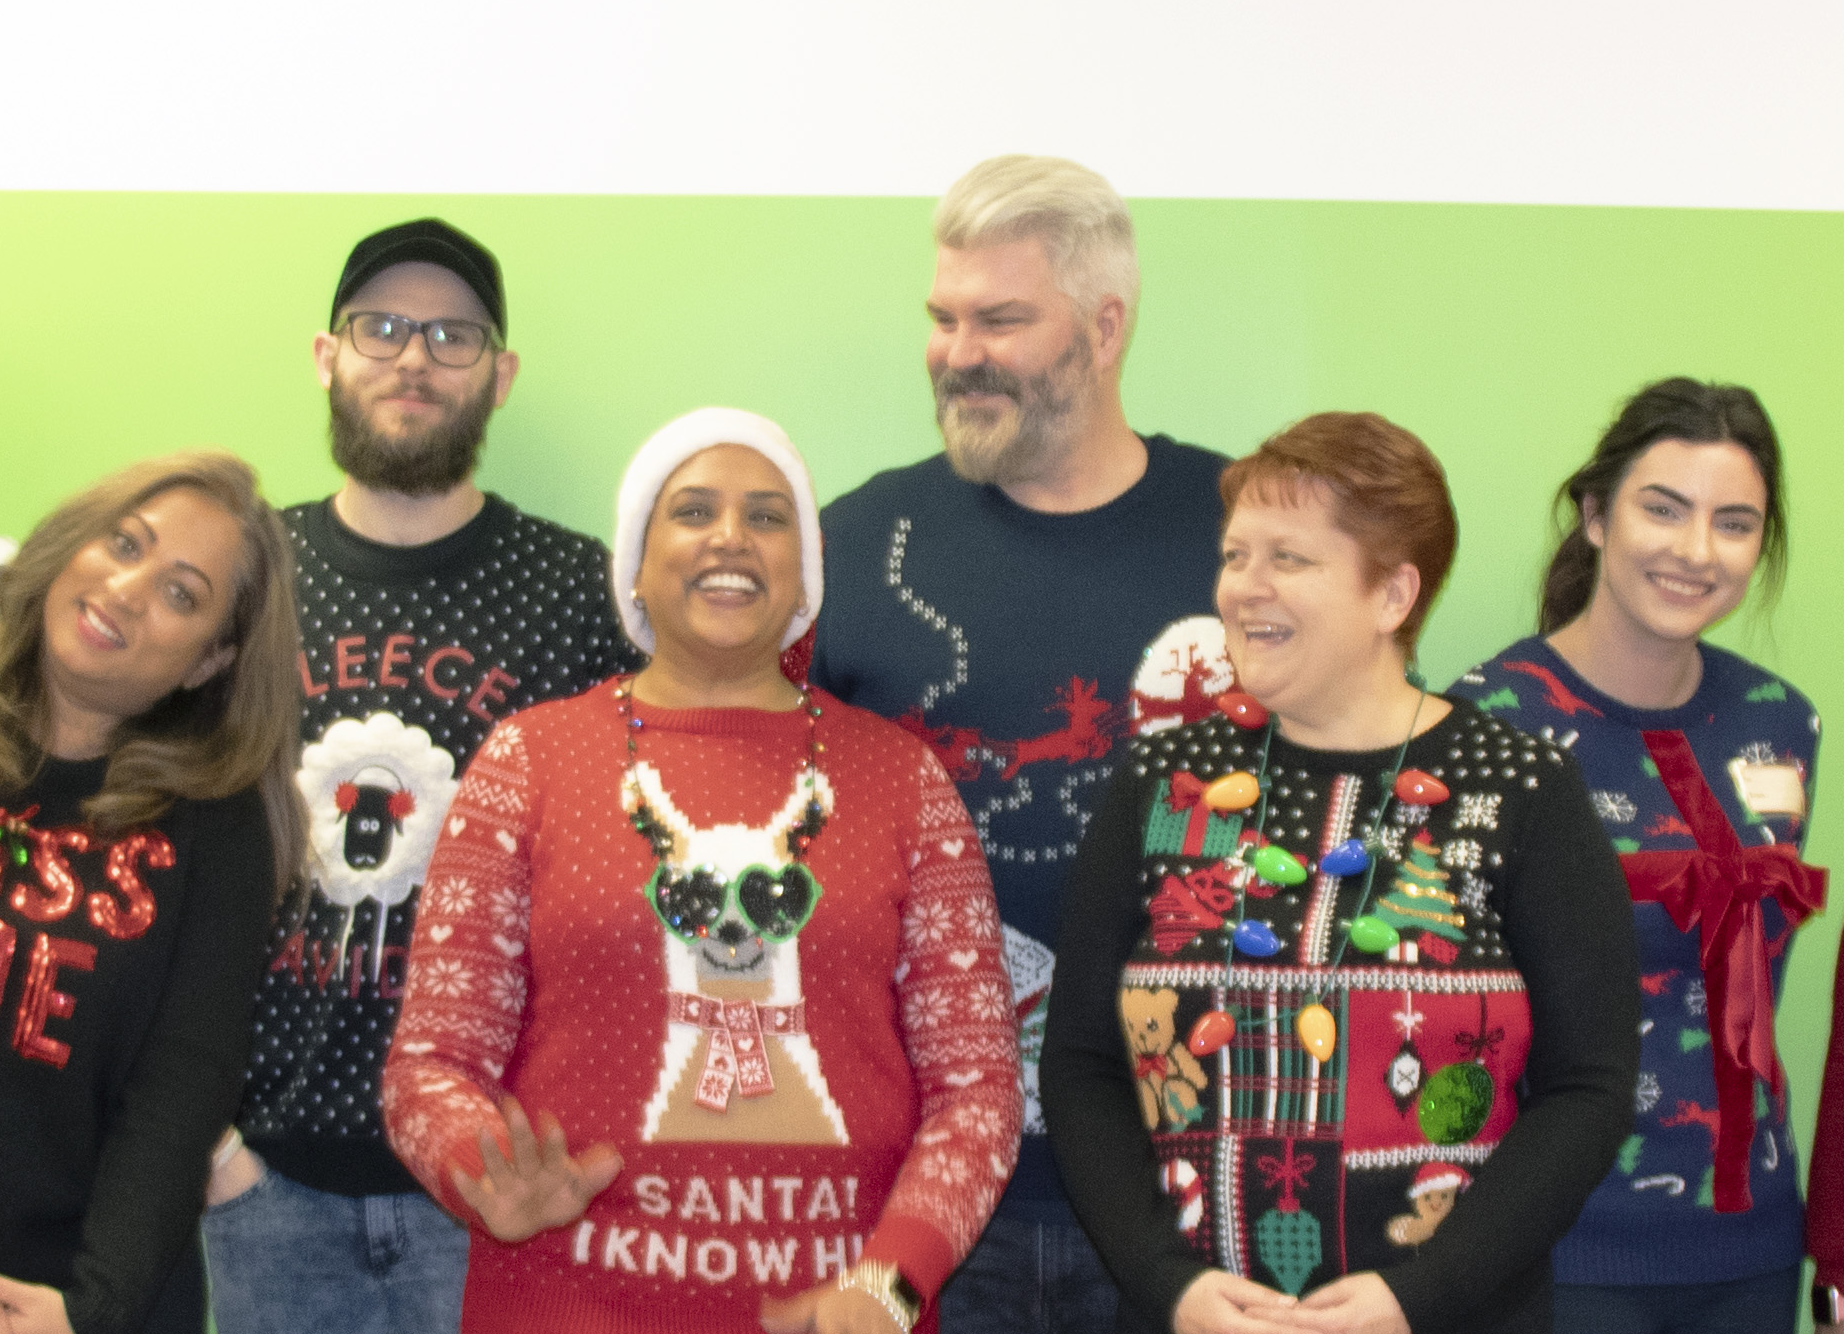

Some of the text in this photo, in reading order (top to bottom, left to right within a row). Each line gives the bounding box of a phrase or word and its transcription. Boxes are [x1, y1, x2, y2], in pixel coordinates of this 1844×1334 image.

[297, 633, 519, 722] LEECE
[633, 1173, 859, 1223] SANTA!
[603, 1225, 799, 1285] KNOW
